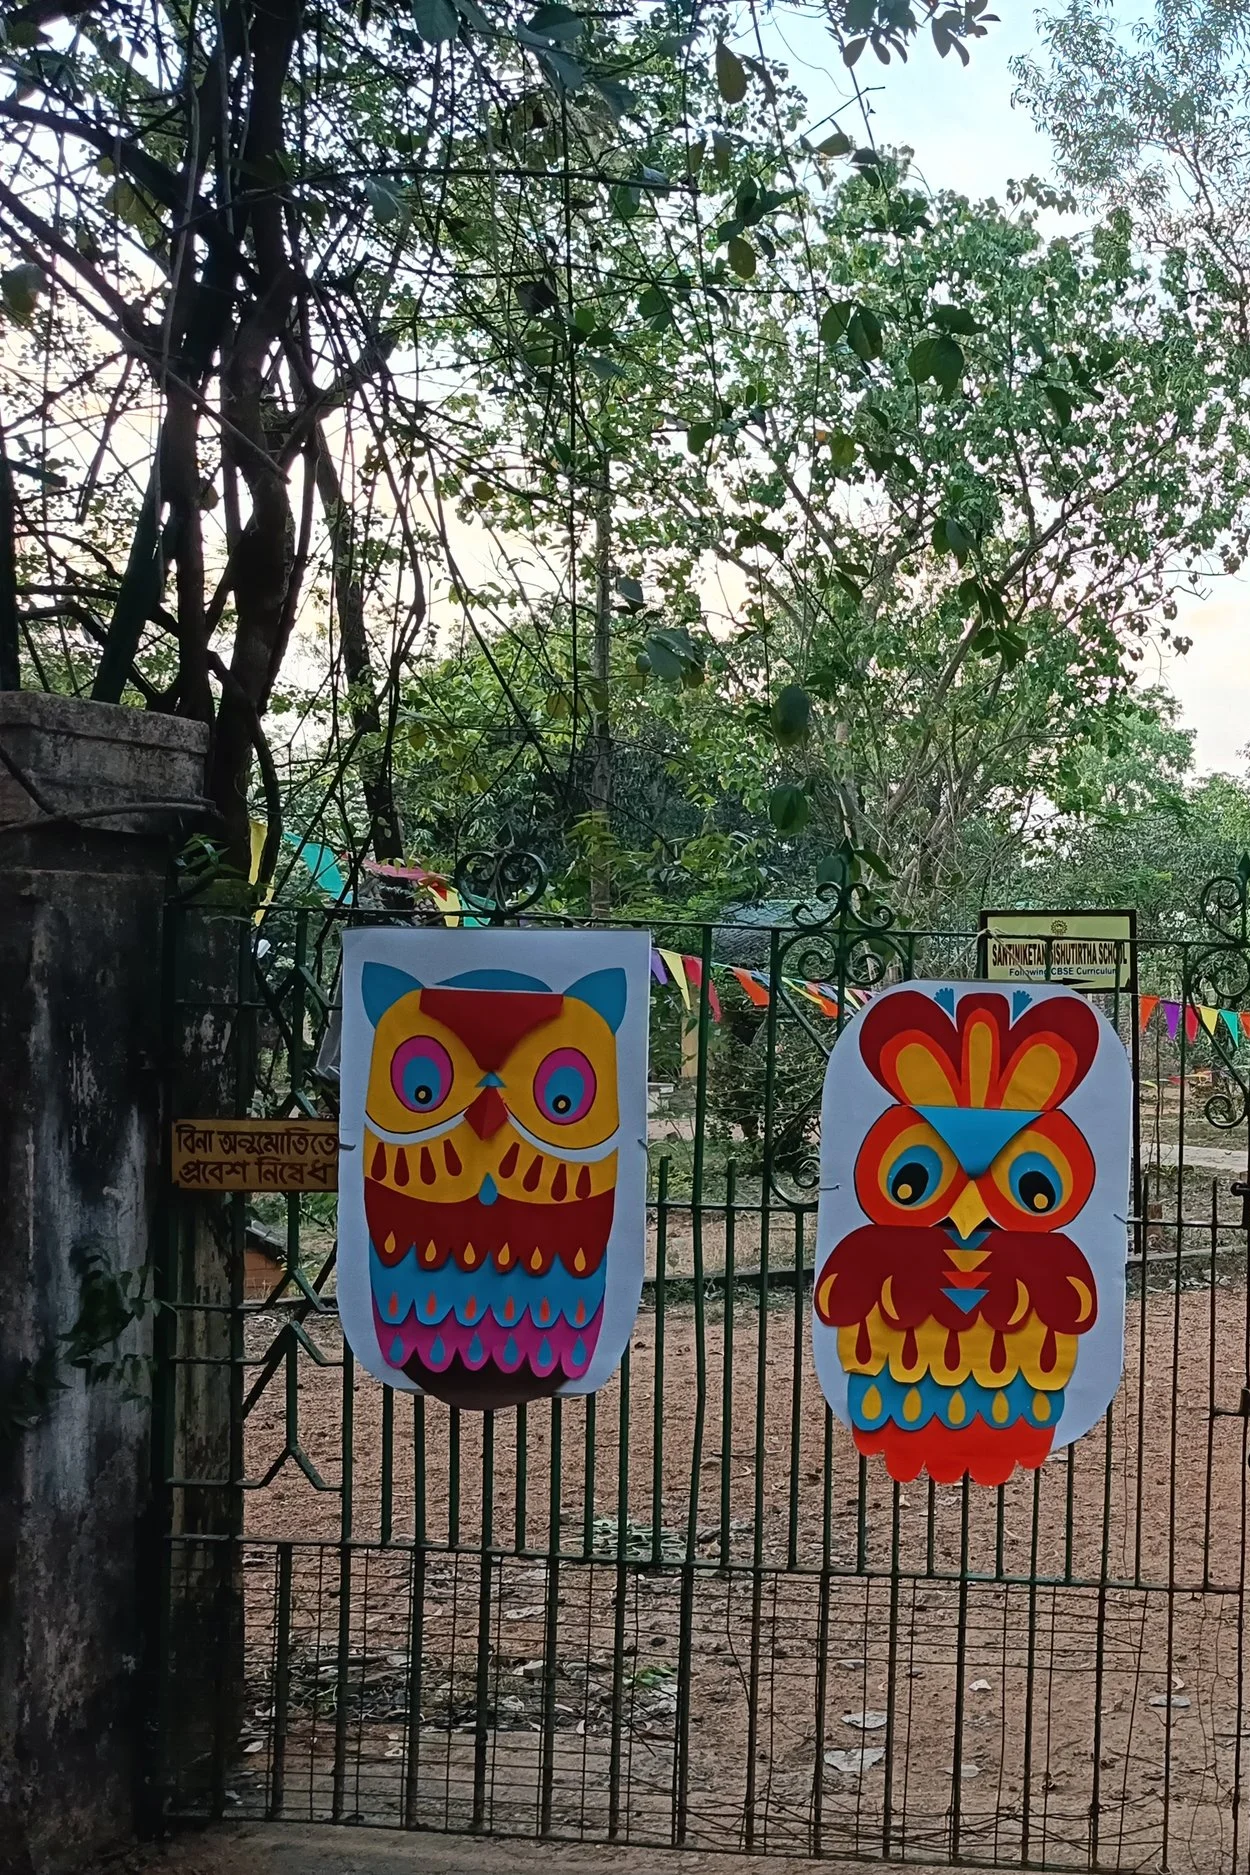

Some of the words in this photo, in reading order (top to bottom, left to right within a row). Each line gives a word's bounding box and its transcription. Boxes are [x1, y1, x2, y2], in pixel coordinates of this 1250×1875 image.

[1051, 967, 1073, 976] CBSE
[175, 1123, 214, 1154] বিনা
[179, 1159, 250, 1184] প্রবেশ
[255, 1156, 335, 1184] নিষেধ
